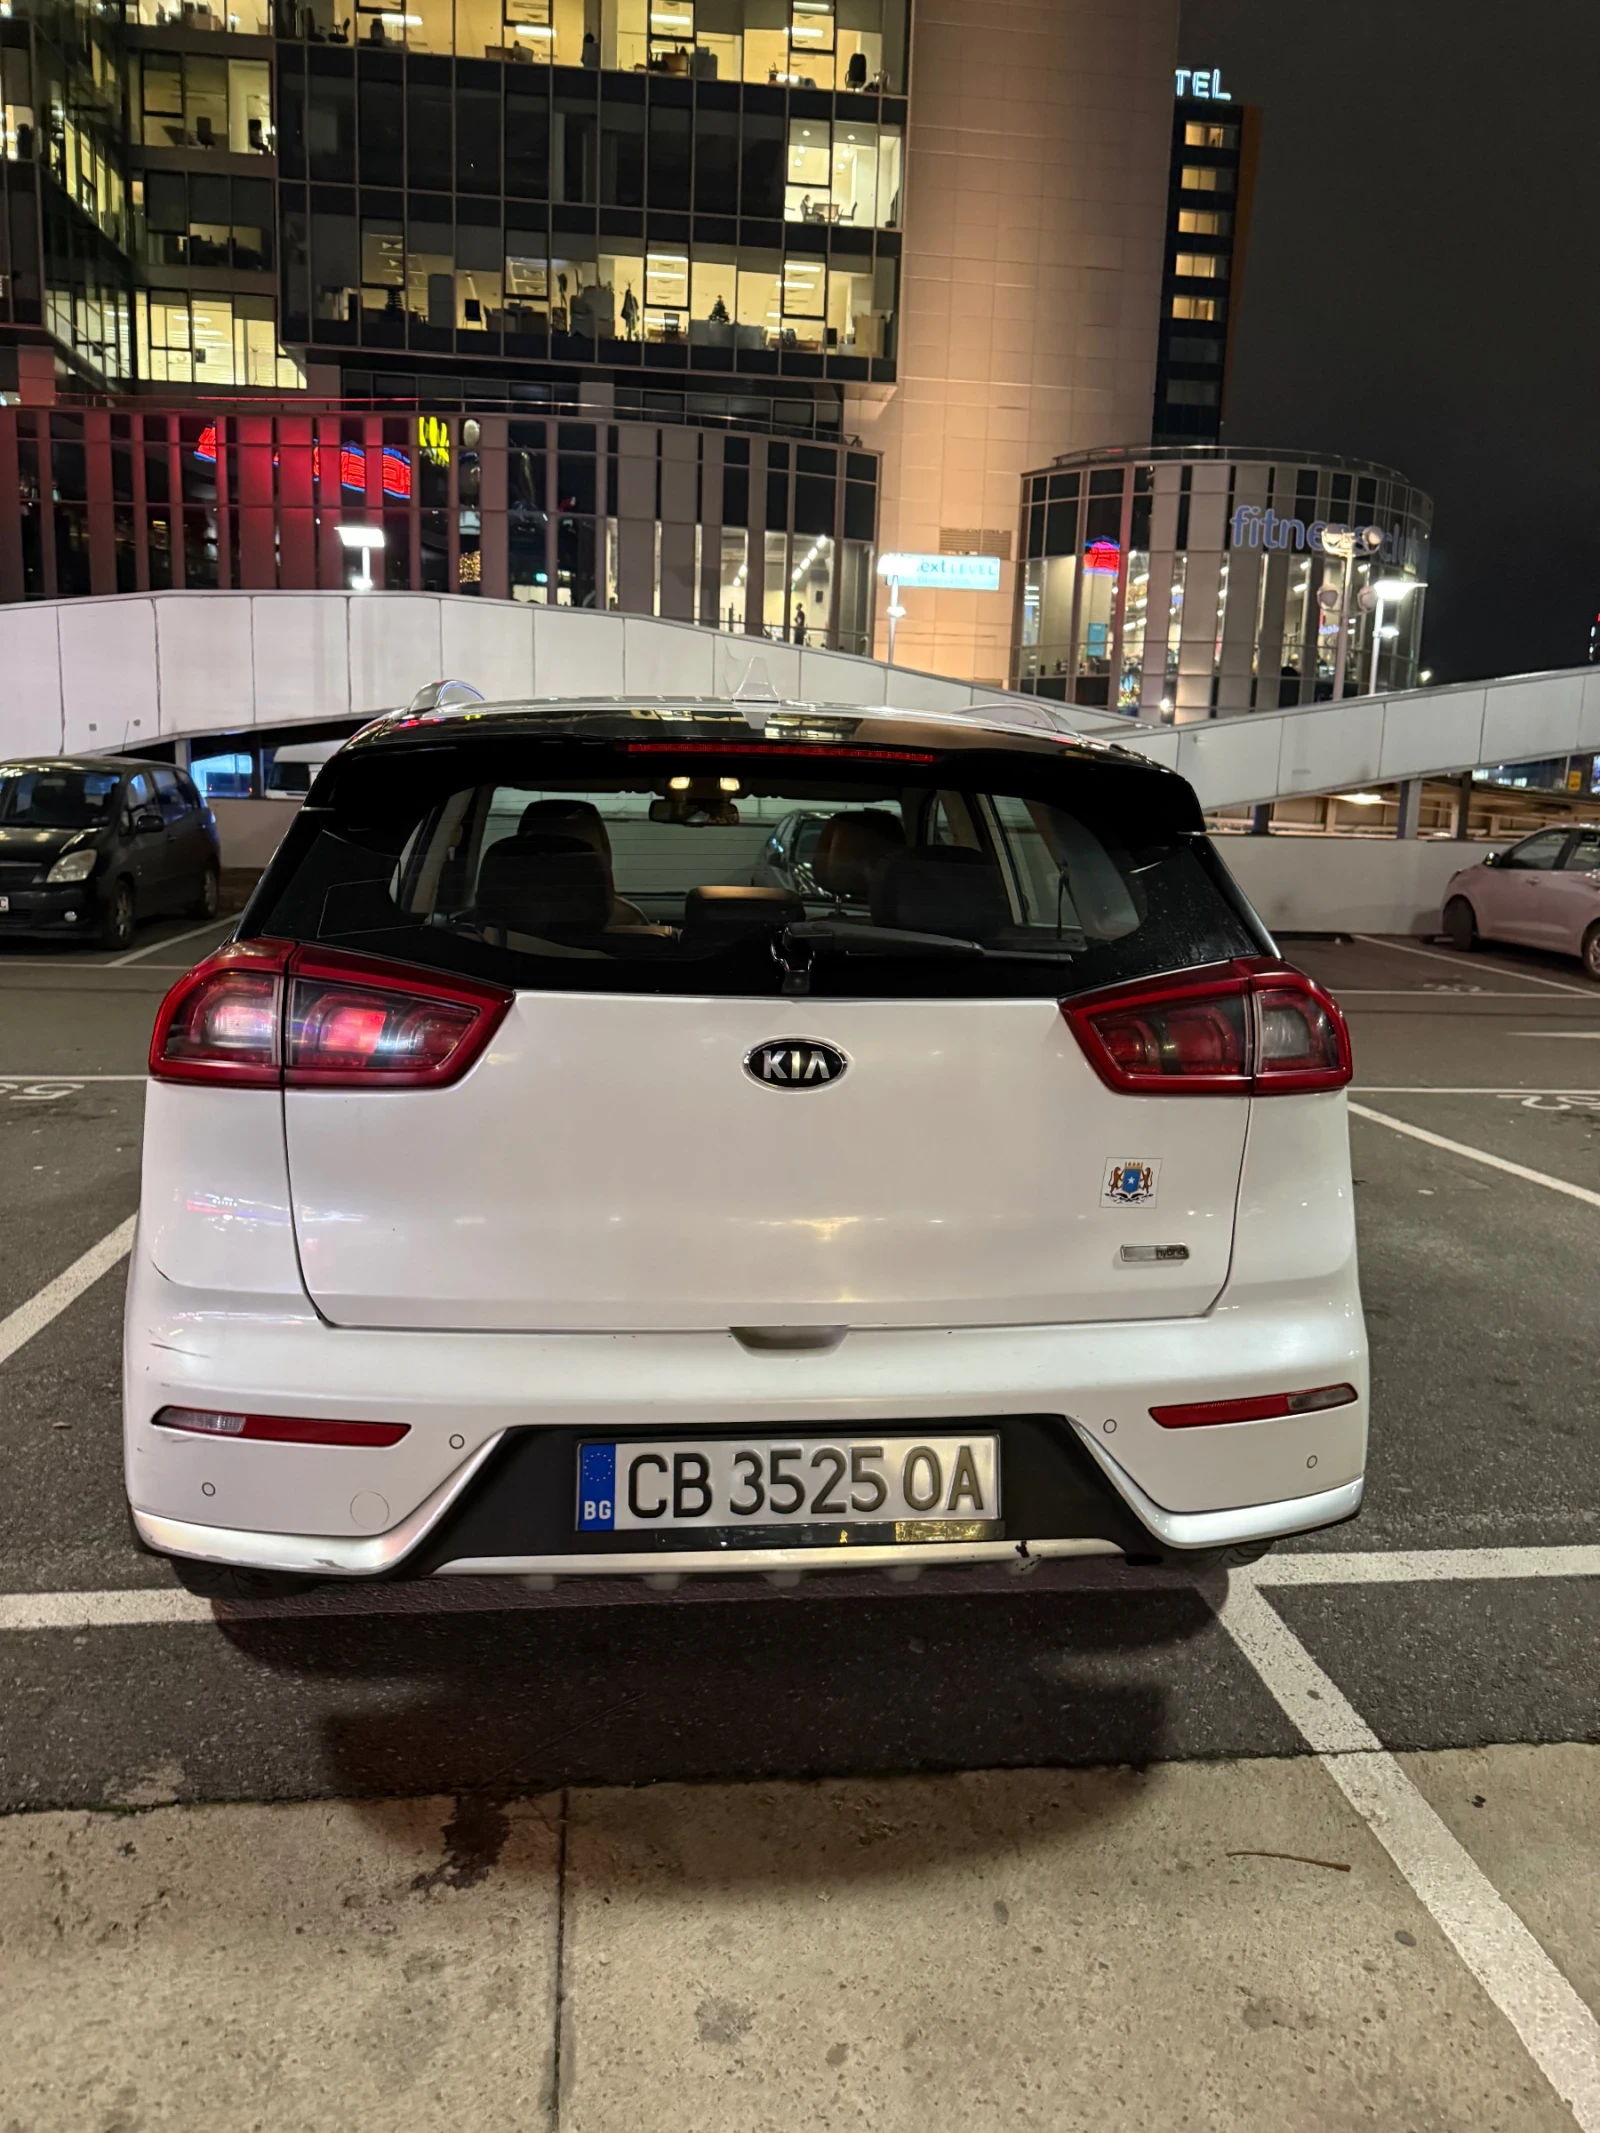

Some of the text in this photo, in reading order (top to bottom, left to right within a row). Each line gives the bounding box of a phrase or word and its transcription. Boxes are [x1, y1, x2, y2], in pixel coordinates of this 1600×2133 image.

[1175, 69, 1231, 101] TEL
[1230, 505, 1368, 552] fitne
[914, 559, 997, 576] ext LEVEL
[762, 1050, 830, 1079] KIA
[627, 1445, 985, 1519] CB 3525 OA
[583, 1500, 612, 1521] BG
